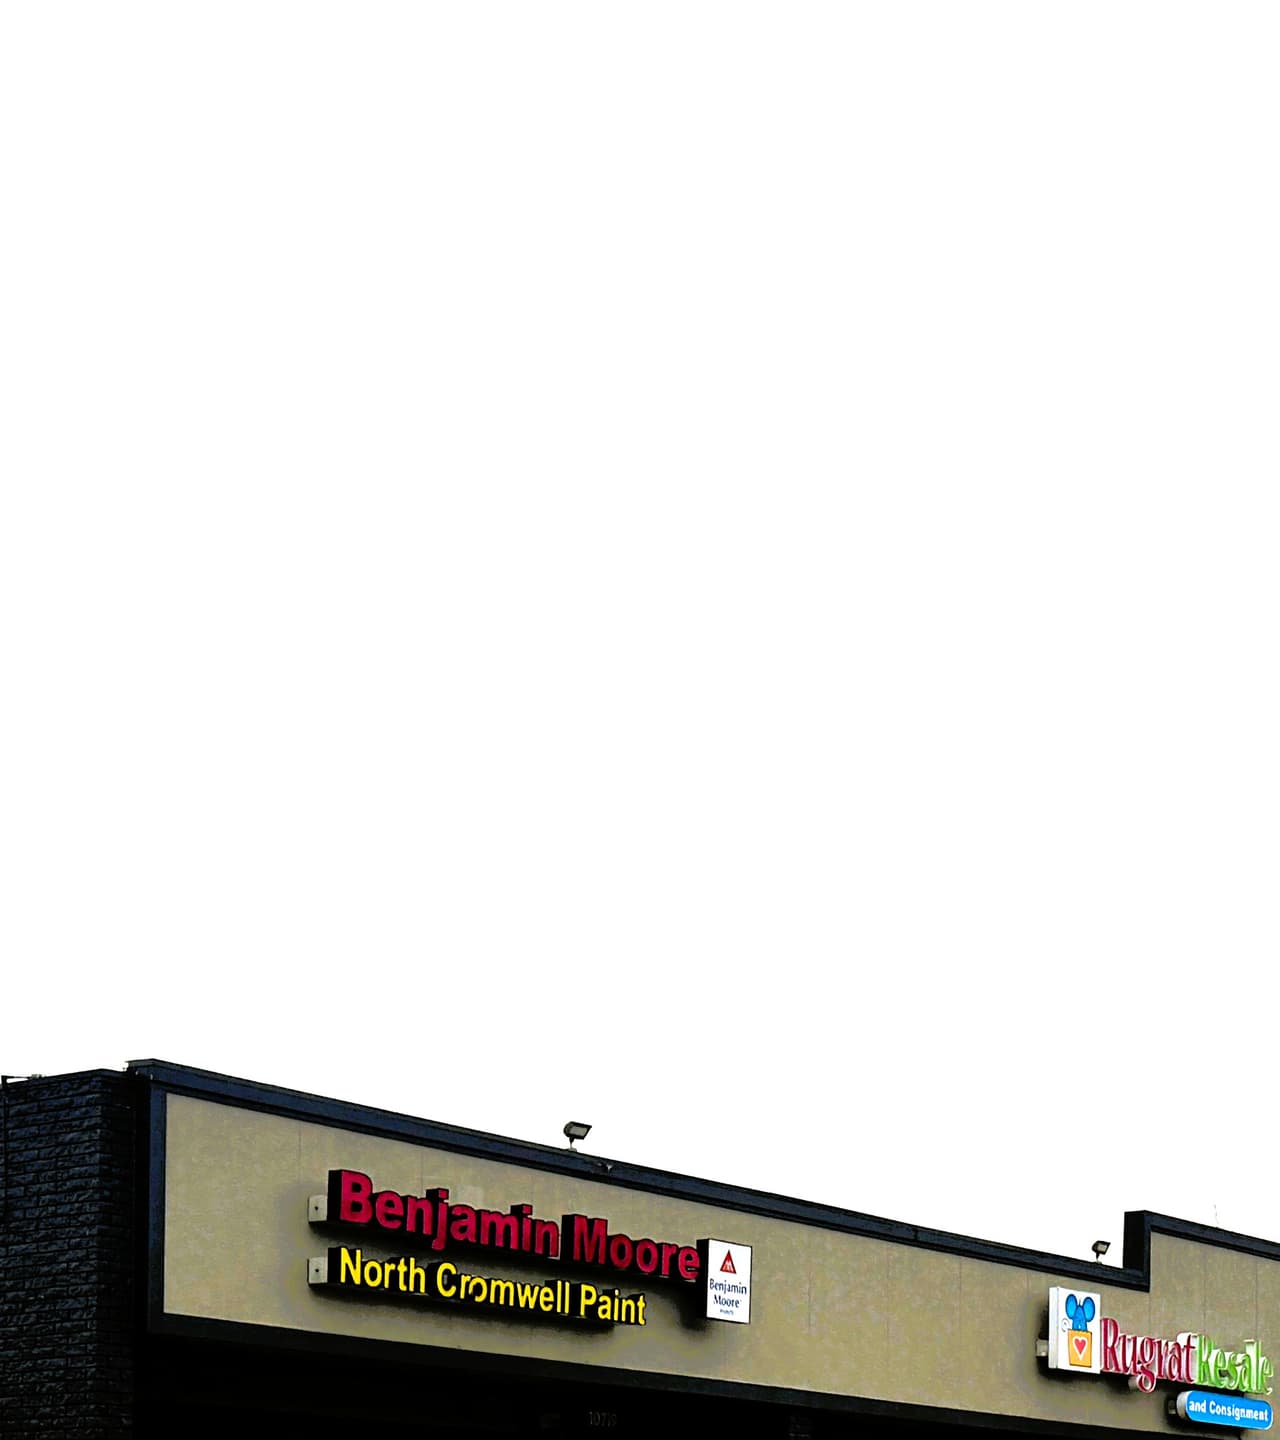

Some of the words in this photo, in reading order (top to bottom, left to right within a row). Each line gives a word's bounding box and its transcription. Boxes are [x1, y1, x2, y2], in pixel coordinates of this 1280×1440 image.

[340, 1170, 559, 1258] Benjamin
[572, 1215, 700, 1280] Moore
[340, 1248, 426, 1294] North
[436, 1262, 570, 1315] Cromwell
[580, 1284, 646, 1326] Paint
[710, 1278, 747, 1295] Benjamin
[714, 1295, 740, 1308] Moore
[1101, 1318, 1195, 1393] Rugrat
[1196, 1334, 1273, 1395] Resale
[1189, 1399, 1206, 1413] and
[1209, 1400, 1269, 1421] Consignment
